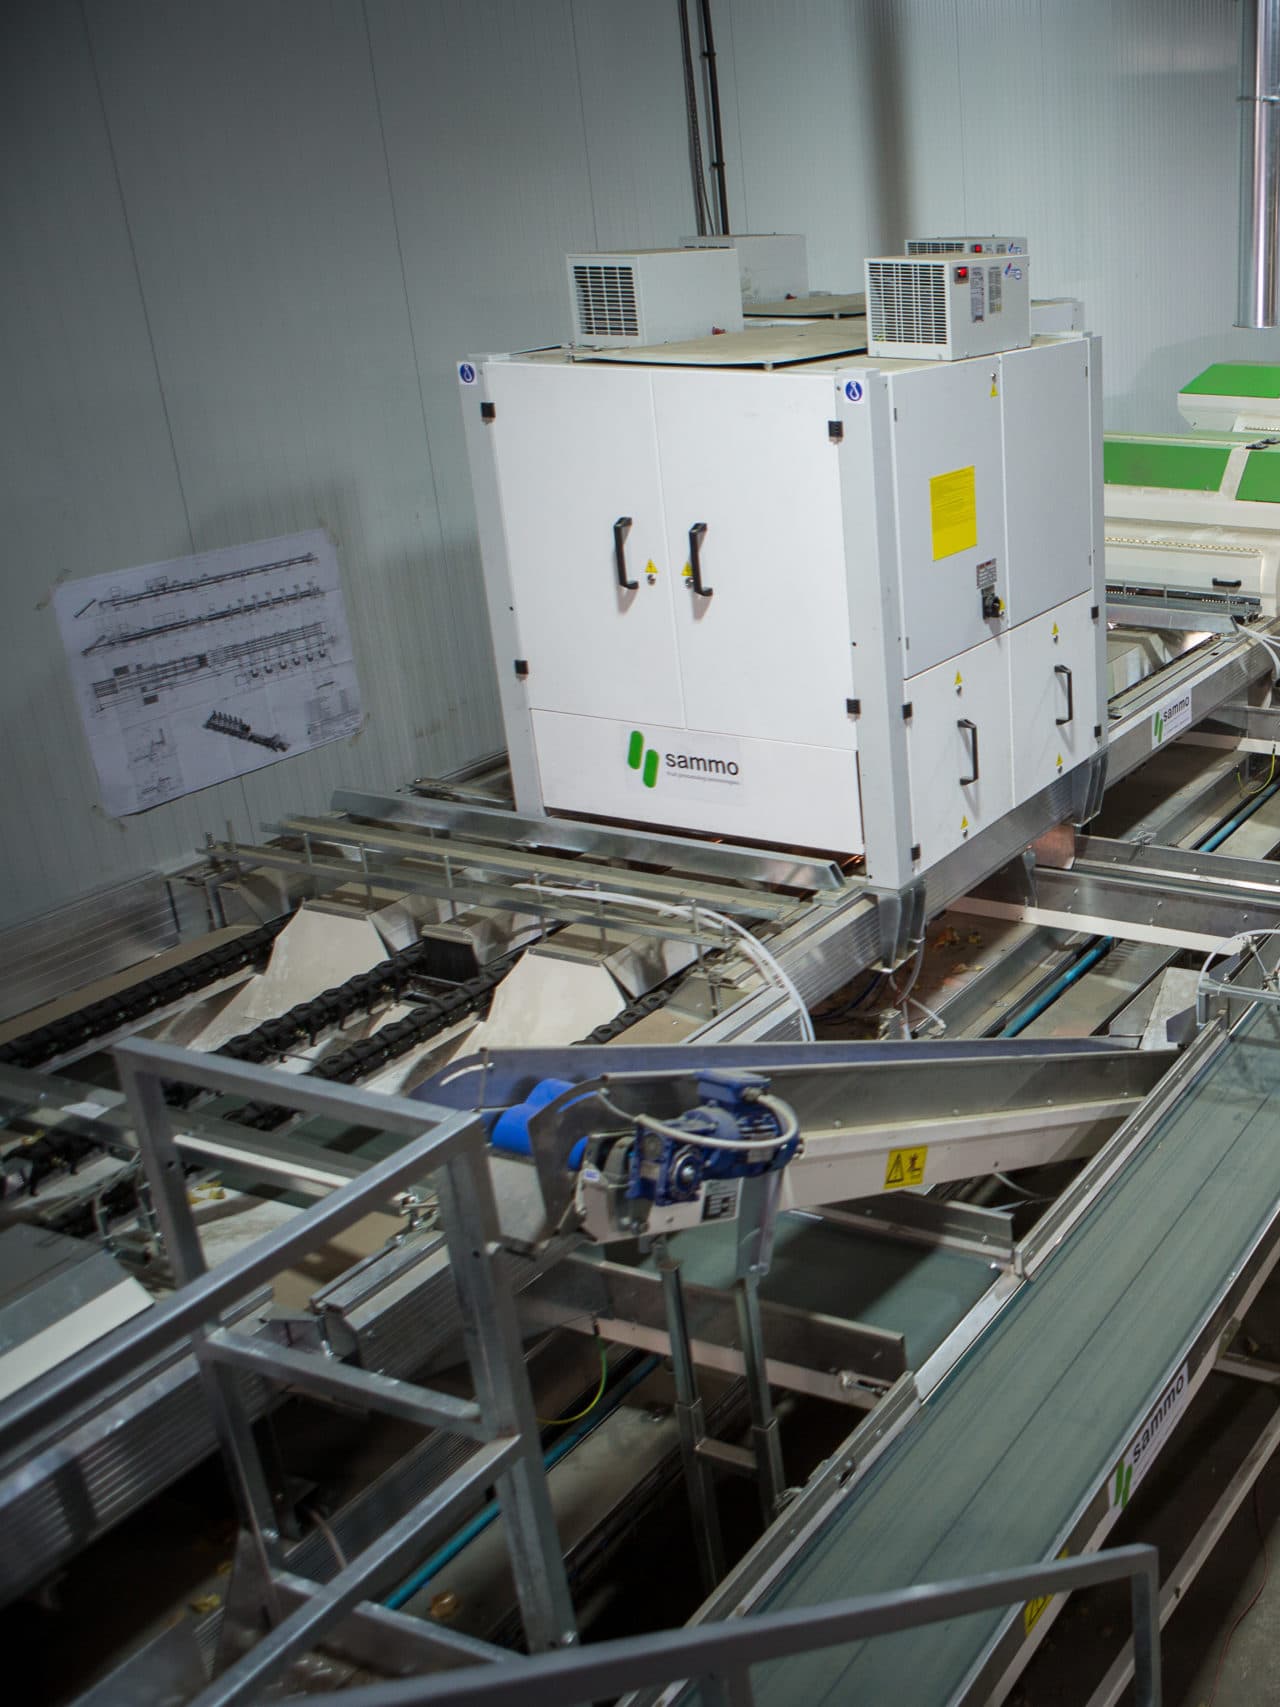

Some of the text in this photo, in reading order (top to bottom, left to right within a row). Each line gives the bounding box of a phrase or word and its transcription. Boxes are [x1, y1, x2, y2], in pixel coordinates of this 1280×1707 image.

[1163, 696, 1190, 722] sammo
[665, 753, 739, 776] sammo
[1133, 1375, 1184, 1464] sammo
